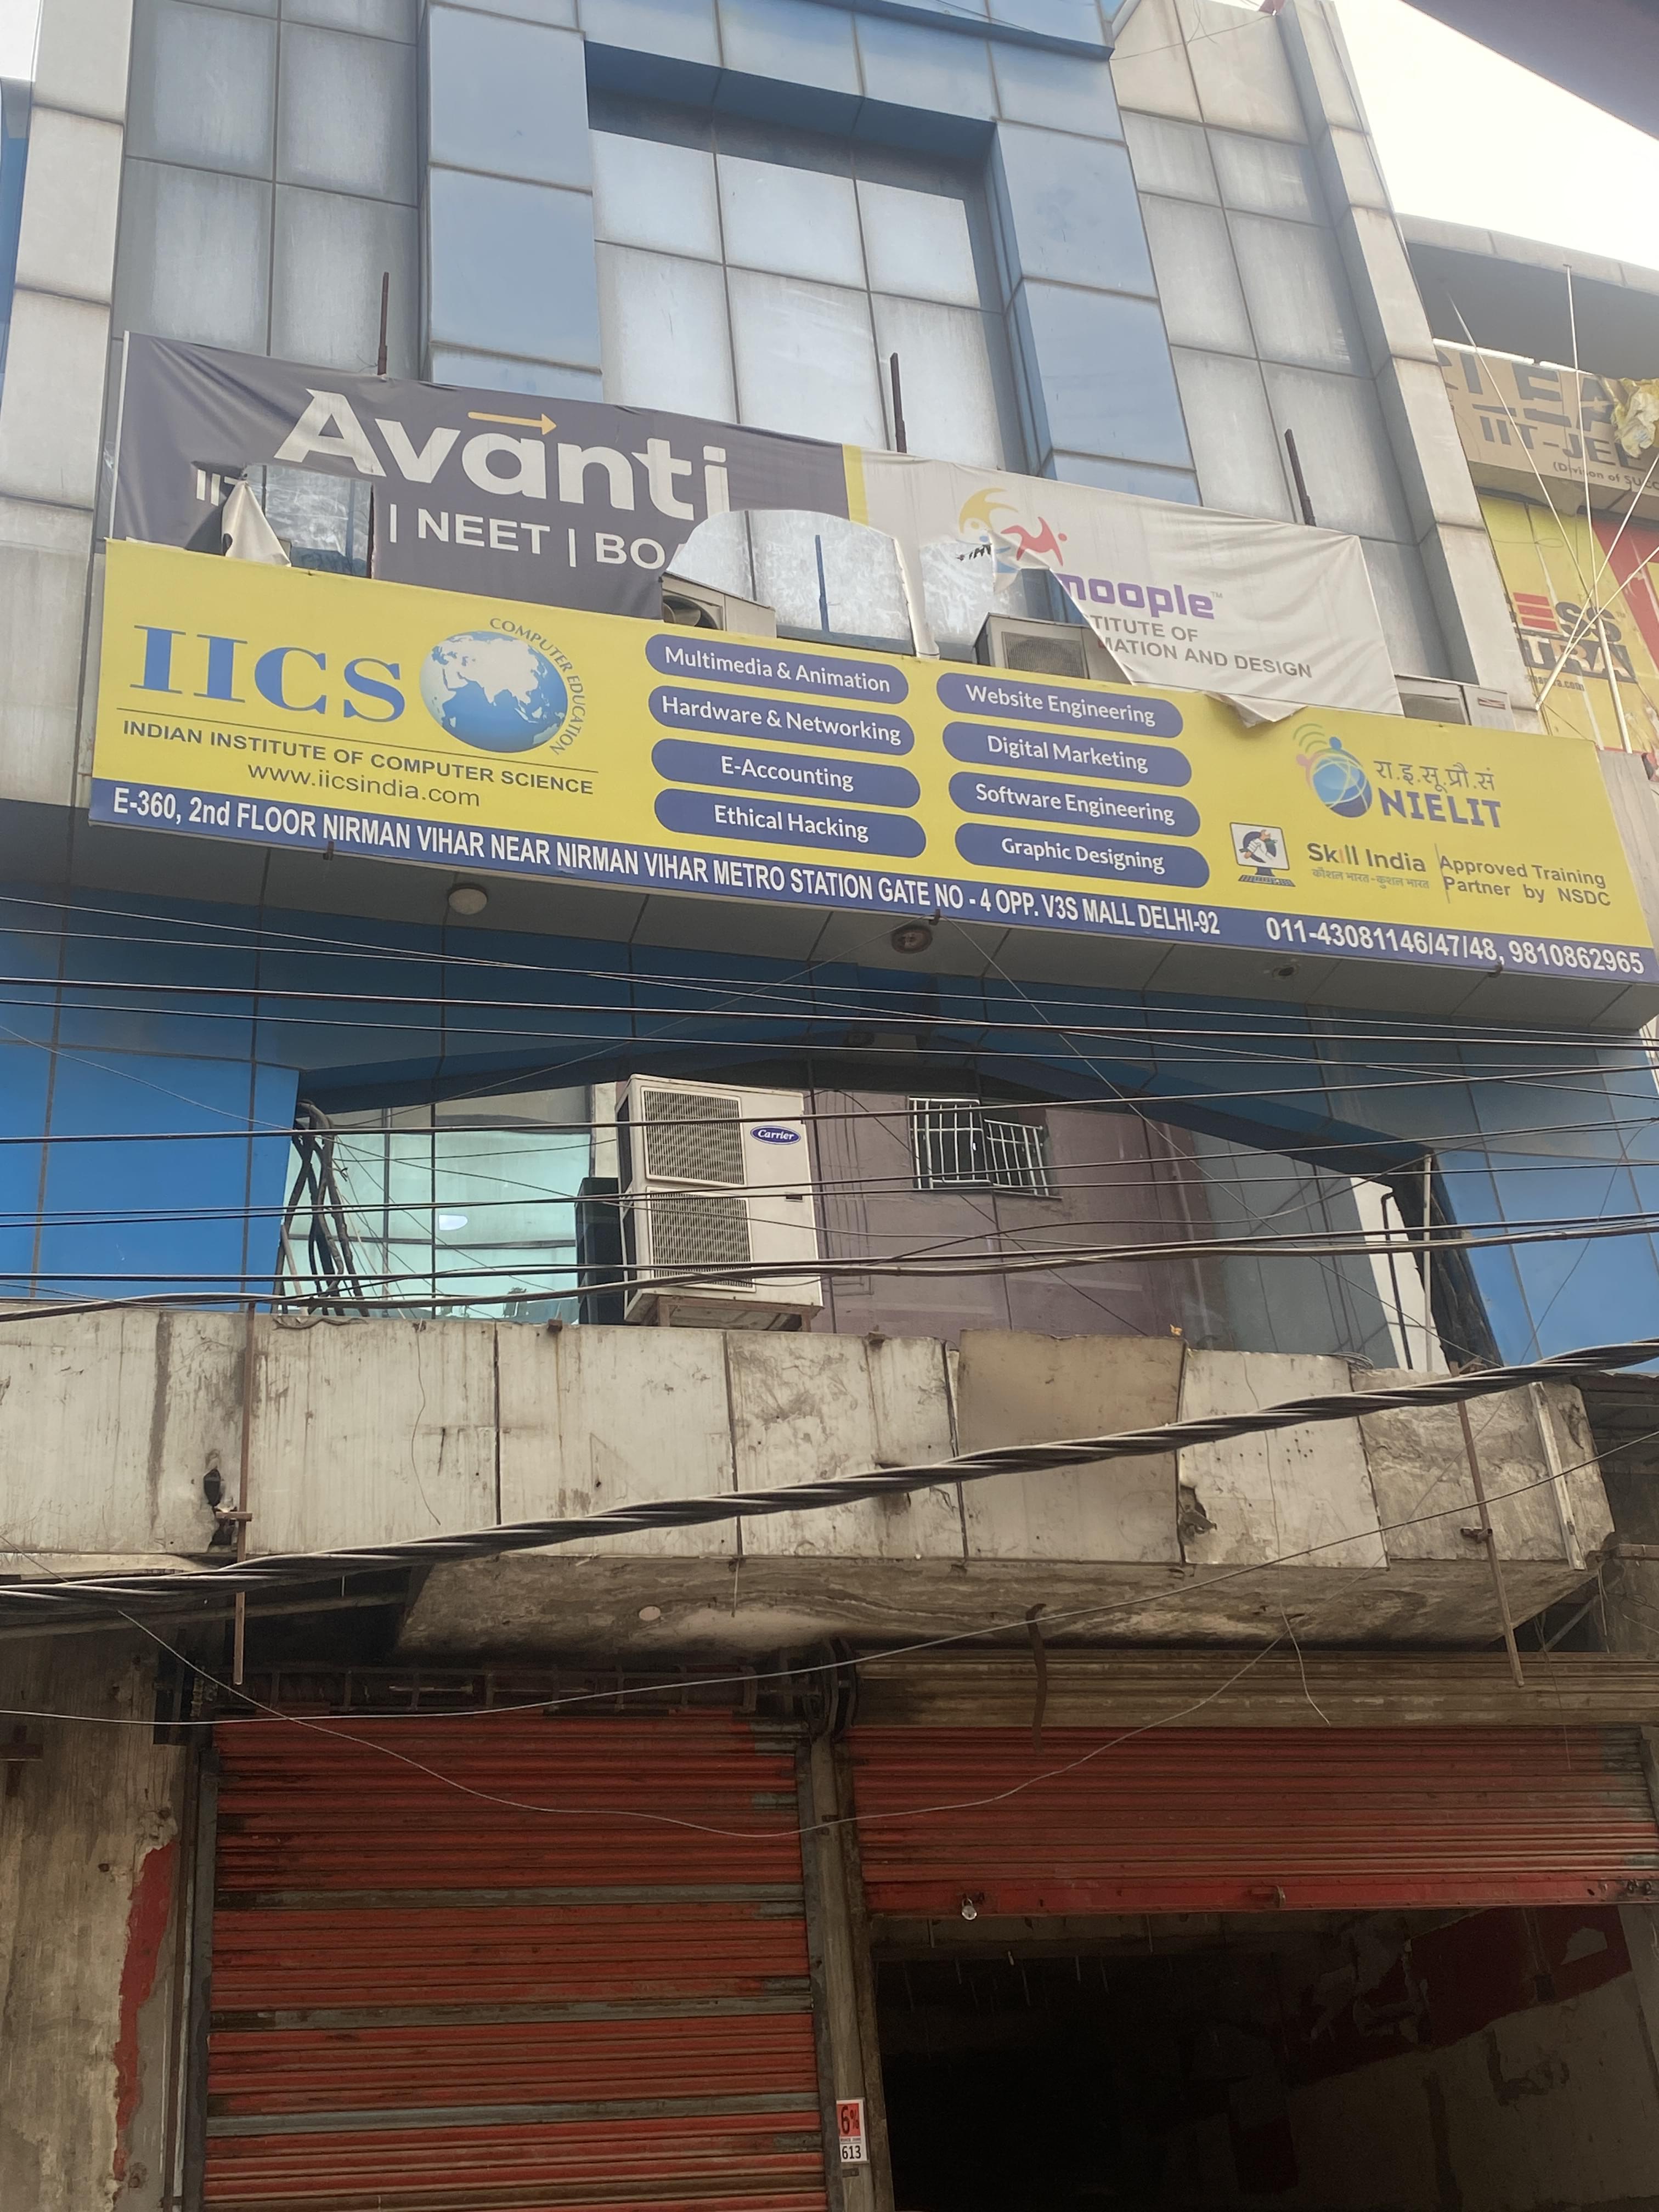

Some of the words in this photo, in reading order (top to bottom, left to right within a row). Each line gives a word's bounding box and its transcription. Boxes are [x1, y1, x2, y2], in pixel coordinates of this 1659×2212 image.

[274, 388, 730, 520] Avanti
[1609, 473, 1621, 483] of
[417, 508, 550, 555] NEET
[1171, 627, 1198, 642] OF
[129, 625, 405, 723] IICS
[665, 646, 772, 678] Multimedia
[777, 663, 791, 680] &
[796, 665, 890, 693] Animation
[1185, 648, 1228, 667] AND
[1234, 656, 1312, 678] DESIGN
[489, 618, 574, 673] COMPUTER
[549, 675, 585, 755] EDUCATION
[966, 684, 1043, 709] Website
[1048, 695, 1155, 727] Engineering
[662, 696, 762, 725] Hardware
[767, 710, 782, 728] &
[787, 712, 901, 746] Networking
[123, 720, 202, 744] INDIAN
[211, 731, 326, 760] INSTITUTE
[334, 748, 363, 765] OF
[370, 753, 494, 783] COMPUTER
[500, 770, 594, 795] SCIENCE
[721, 755, 854, 792] E-Accounting
[988, 735, 1049, 759] Digital
[1052, 743, 1148, 774] Marketing
[248, 764, 481, 807] www.iicsindia.com
[975, 783, 1062, 809] Software
[1065, 794, 1175, 826] Engineering
[714, 804, 782, 831] Ethical
[788, 813, 868, 843] Hacking
[1378, 788, 1501, 828] NIELIT
[113, 787, 182, 824] E-360,
[188, 799, 230, 826] 2nd
[236, 803, 316, 838] FLOOR
[323, 812, 410, 849] NIRMAN
[416, 825, 485, 858] VIHAR
[490, 833, 551, 865] NEAR
[556, 842, 639, 875] NIRMAN
[644, 851, 709, 883] VIHAR
[713, 859, 784, 891] METRO
[791, 866, 873, 901] STATION
[878, 877, 930, 907] GATE
[935, 883, 963, 909] NO
[980, 888, 991, 912] 4
[996, 890, 1039, 917] OPP.
[1042, 894, 1079, 921] V3S
[1082, 899, 1135, 928] MALL
[1138, 905, 1221, 935] DELHI-92
[1002, 838, 1070, 861] Graphic
[1075, 846, 1165, 874] Designing
[1307, 843, 1359, 865] Skill
[1365, 849, 1426, 872] India
[1440, 855, 1528, 878] Approved
[1532, 864, 1606, 889] Training
[1443, 876, 1510, 896] Partner
[1523, 884, 1545, 904] by
[1558, 888, 1611, 906] NSDC
[1510, 939, 1645, 974] 9810862965
[758, 1130, 794, 1139] Carrier
[841, 2105, 859, 2135] 6%
[842, 2145, 861, 2159] 613
